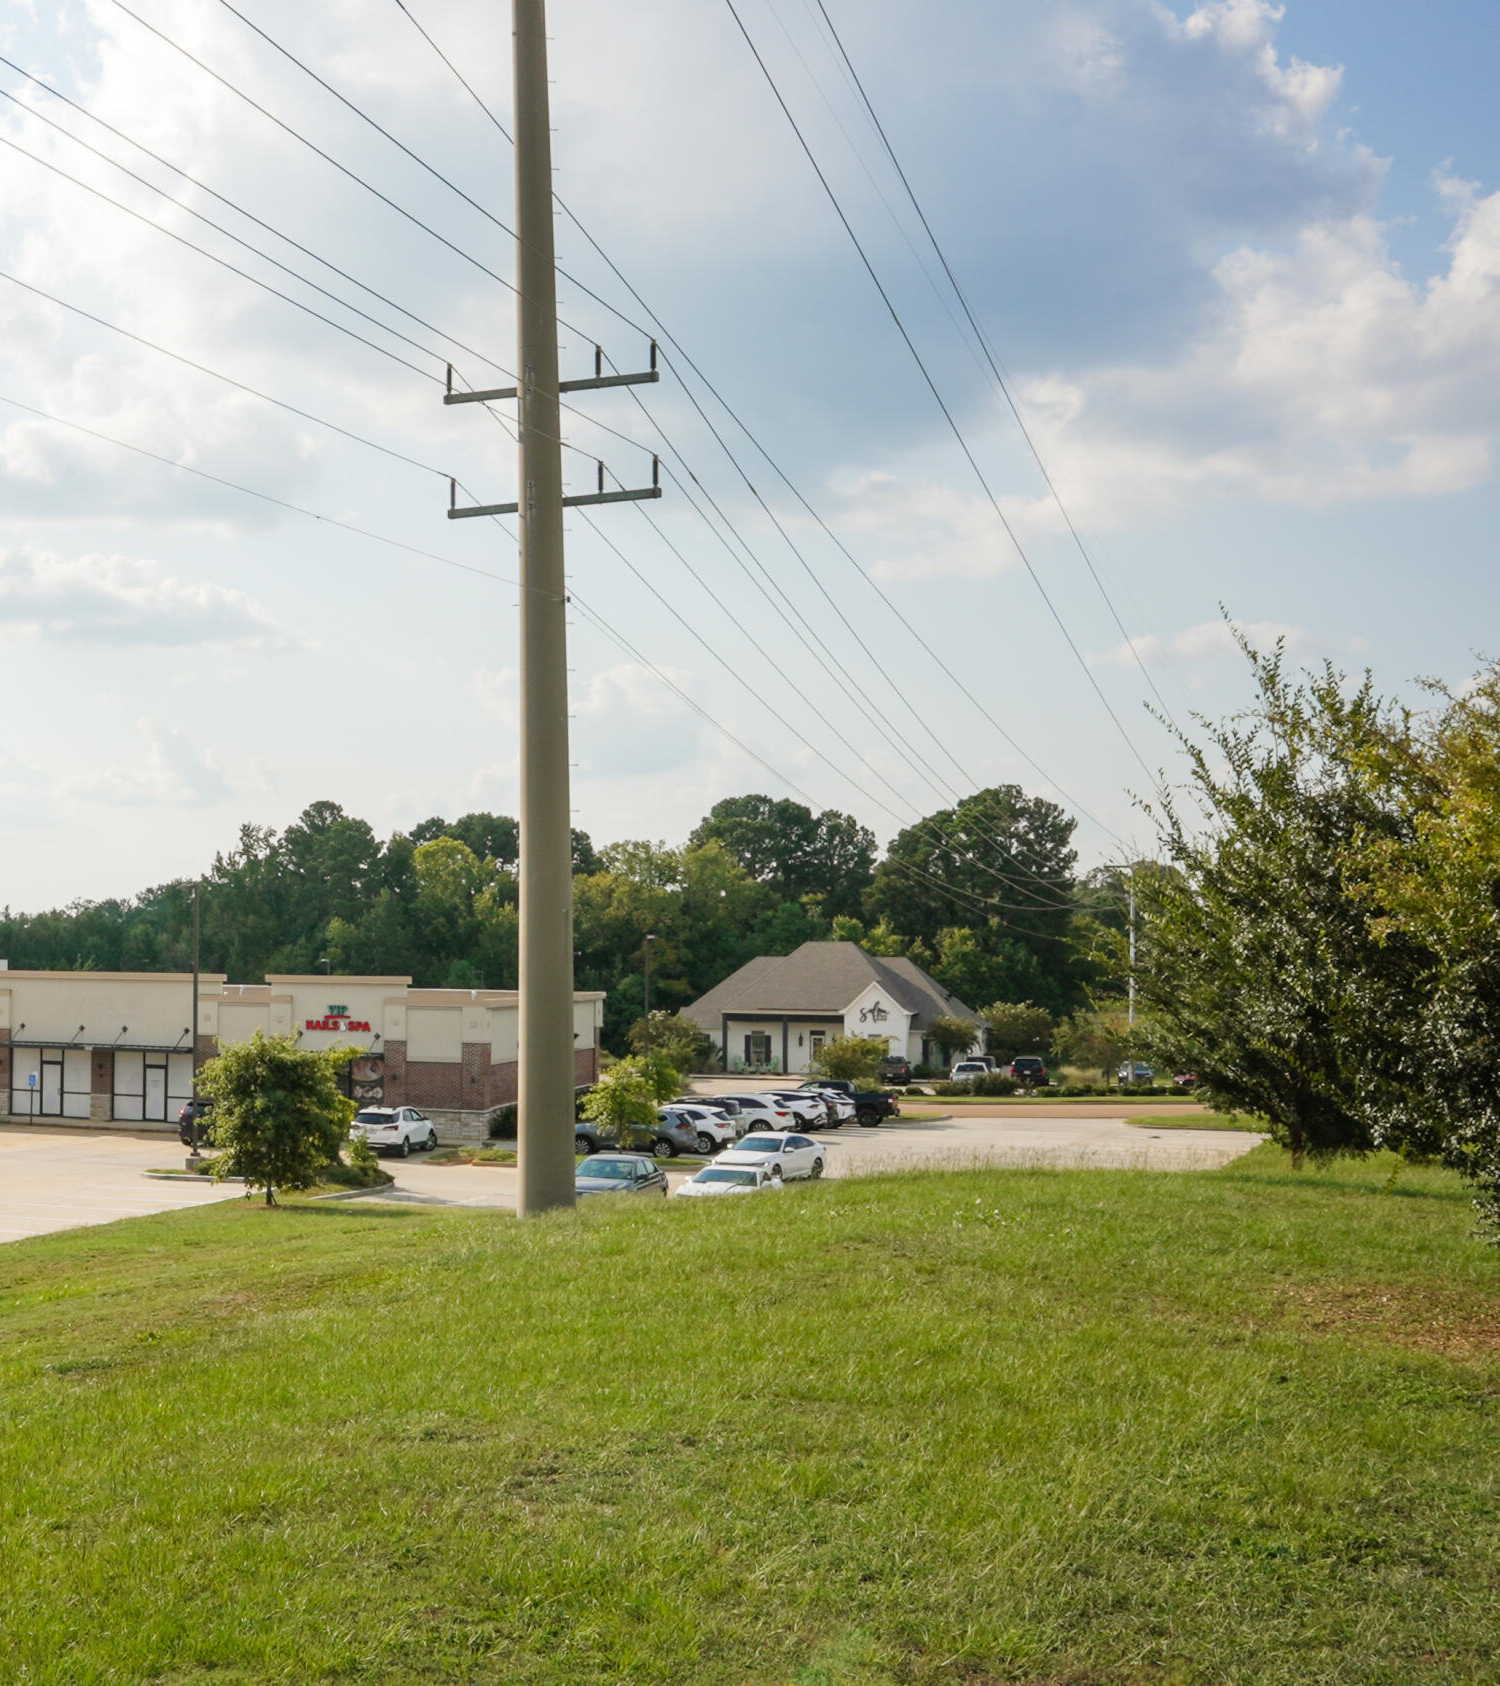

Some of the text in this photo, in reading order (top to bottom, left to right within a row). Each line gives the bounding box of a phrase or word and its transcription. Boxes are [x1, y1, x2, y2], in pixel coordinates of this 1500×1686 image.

[327, 1004, 349, 1016] VIP
[305, 1019, 339, 1031] NAILS
[347, 1020, 372, 1032] SPA
